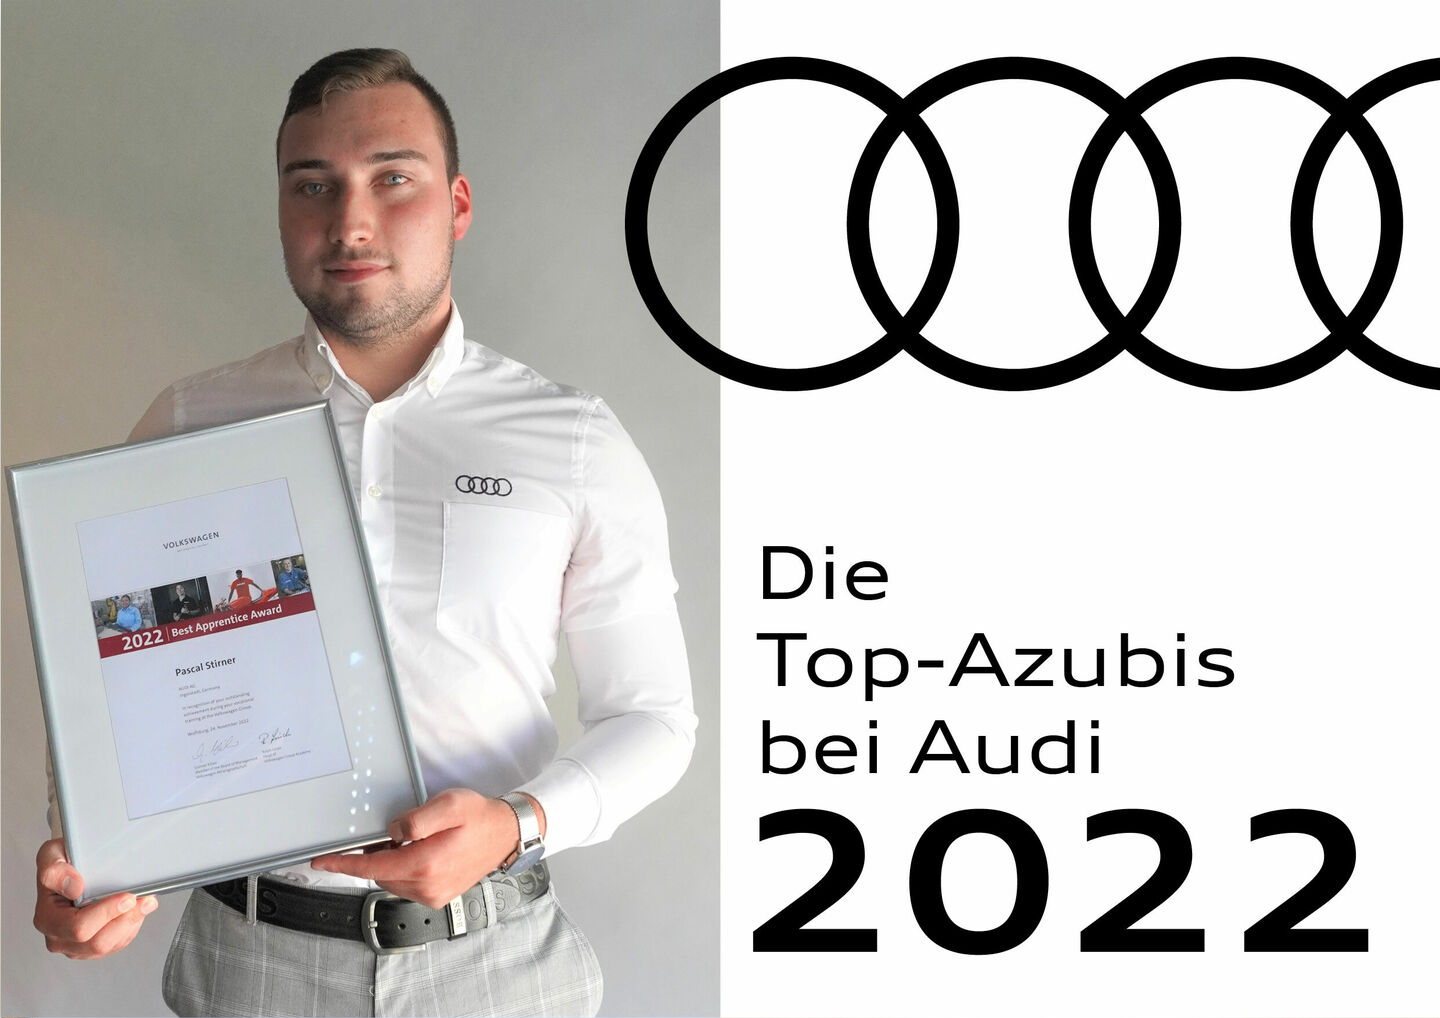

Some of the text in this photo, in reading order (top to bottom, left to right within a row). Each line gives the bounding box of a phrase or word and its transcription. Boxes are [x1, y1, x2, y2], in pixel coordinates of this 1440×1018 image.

[163, 531, 219, 550] VOLKSWAGEN
[122, 604, 283, 651] 2022 Best Apprentice Award
[175, 657, 236, 676] Pascal Stirner
